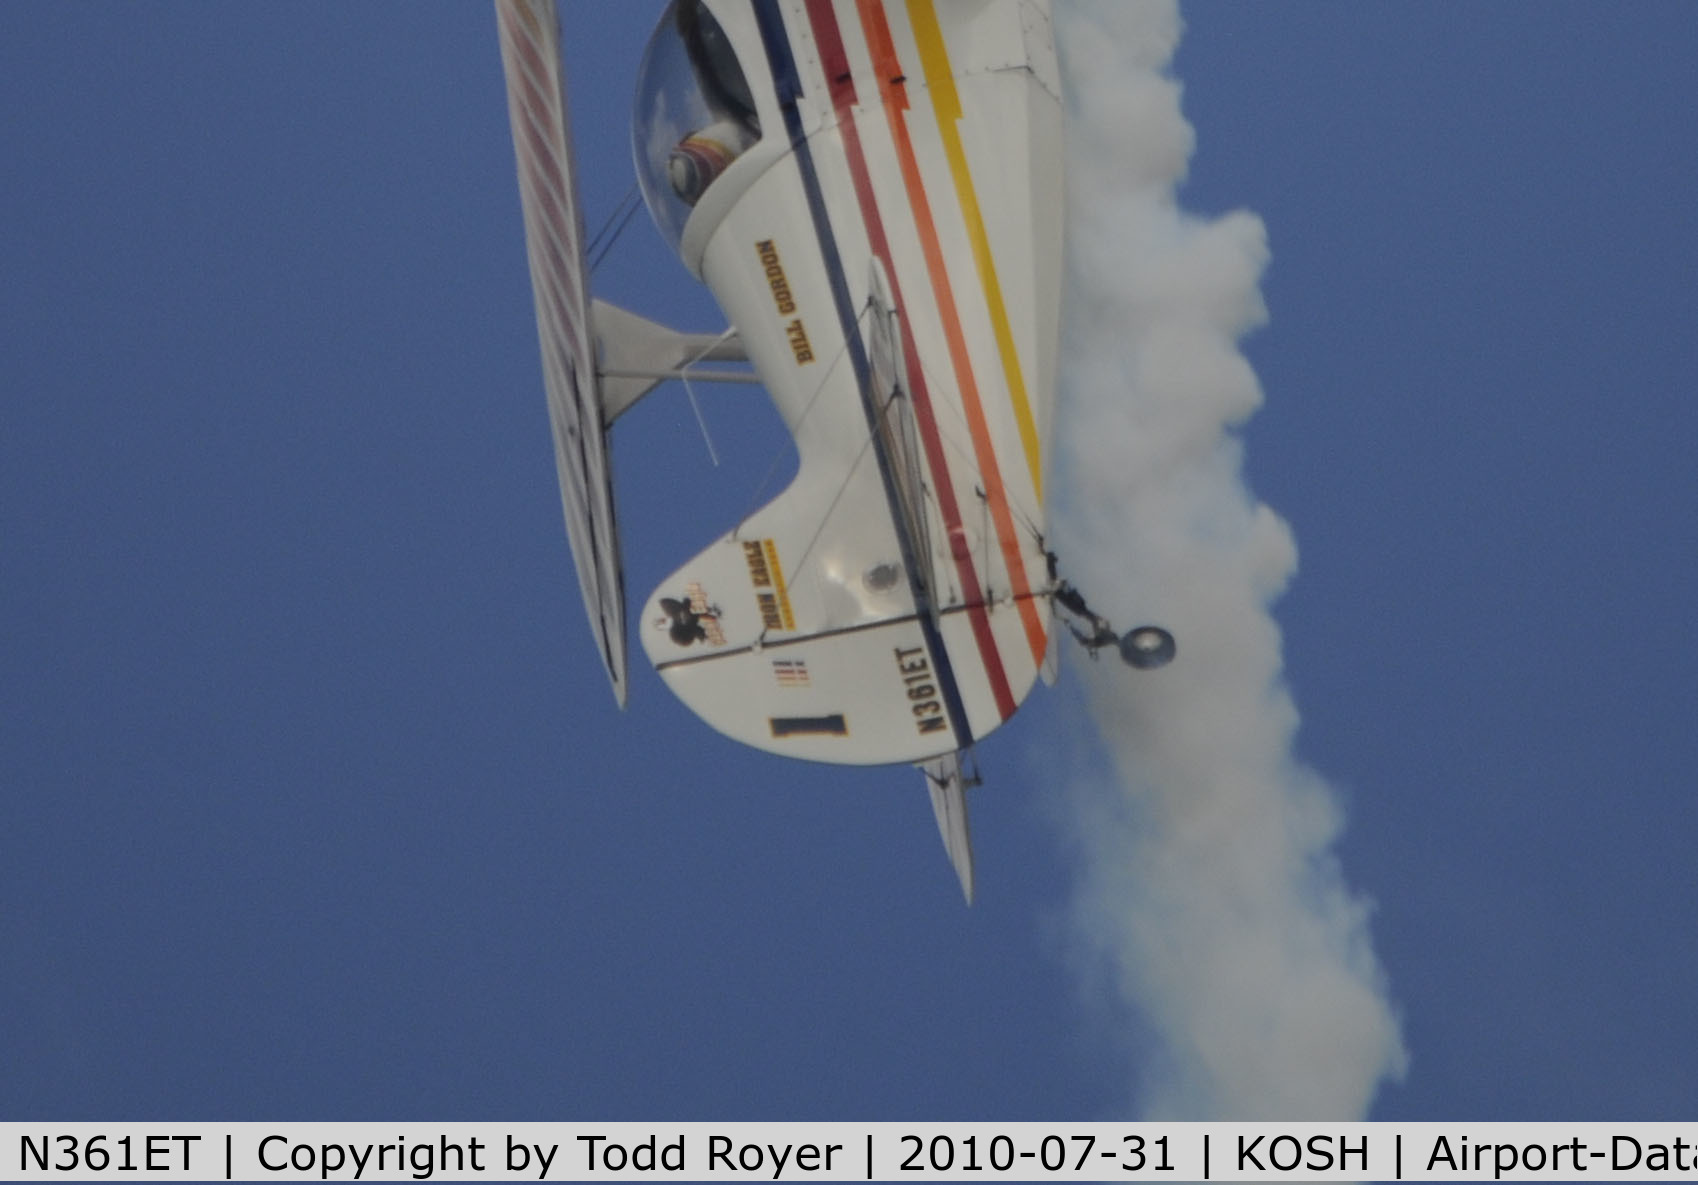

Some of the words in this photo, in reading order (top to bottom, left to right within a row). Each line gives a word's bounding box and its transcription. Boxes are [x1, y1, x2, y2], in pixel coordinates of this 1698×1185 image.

[755, 239, 797, 316] GORDON
[785, 318, 816, 367] BILL
[742, 539, 772, 588] EAGLE
[894, 646, 948, 736] N361ET
